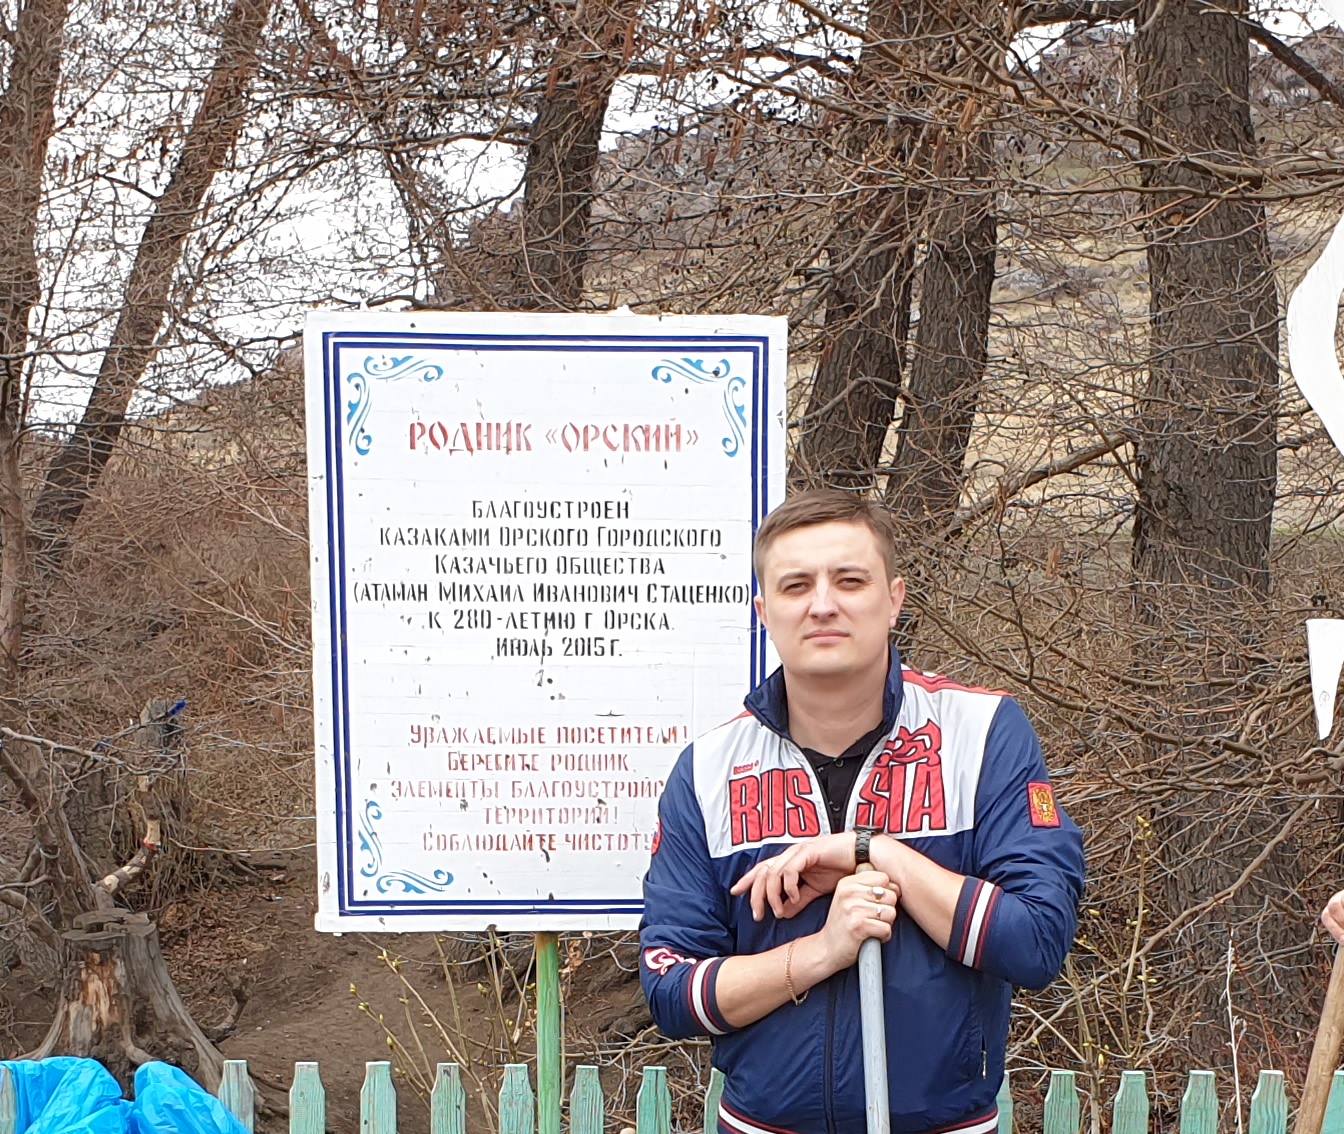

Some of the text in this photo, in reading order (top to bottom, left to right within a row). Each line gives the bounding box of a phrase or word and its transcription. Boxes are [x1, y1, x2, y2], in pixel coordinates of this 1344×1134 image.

[409, 417, 699, 456] РОДНИК «ОРСКИЙ»
[472, 500, 629, 519] БЛАГОУСТРОЕН
[380, 526, 722, 547] КАЗАКАМИ ОРСКОГО ГОРОДСКОГО
[435, 554, 665, 576] КАЗАЧЬЕГО ОБЩЕСТВА
[353, 581, 750, 606] (АТАМАН МИХАИЛ ИВАНОВИЧ СТАЦЕНКО)
[429, 610, 442, 630] К
[496, 637, 553, 657] ИЮЛЬ
[410, 724, 688, 744] УВАЖАЕМЫЕ ПОСЕТИТЕЛИ!
[391, 780, 498, 799] ЭЛЕМЕНТЫ
[483, 806, 618, 825] ТЕРРИТОРИИ!
[423, 829, 556, 851] СОБЛЮДАЙТЕ
